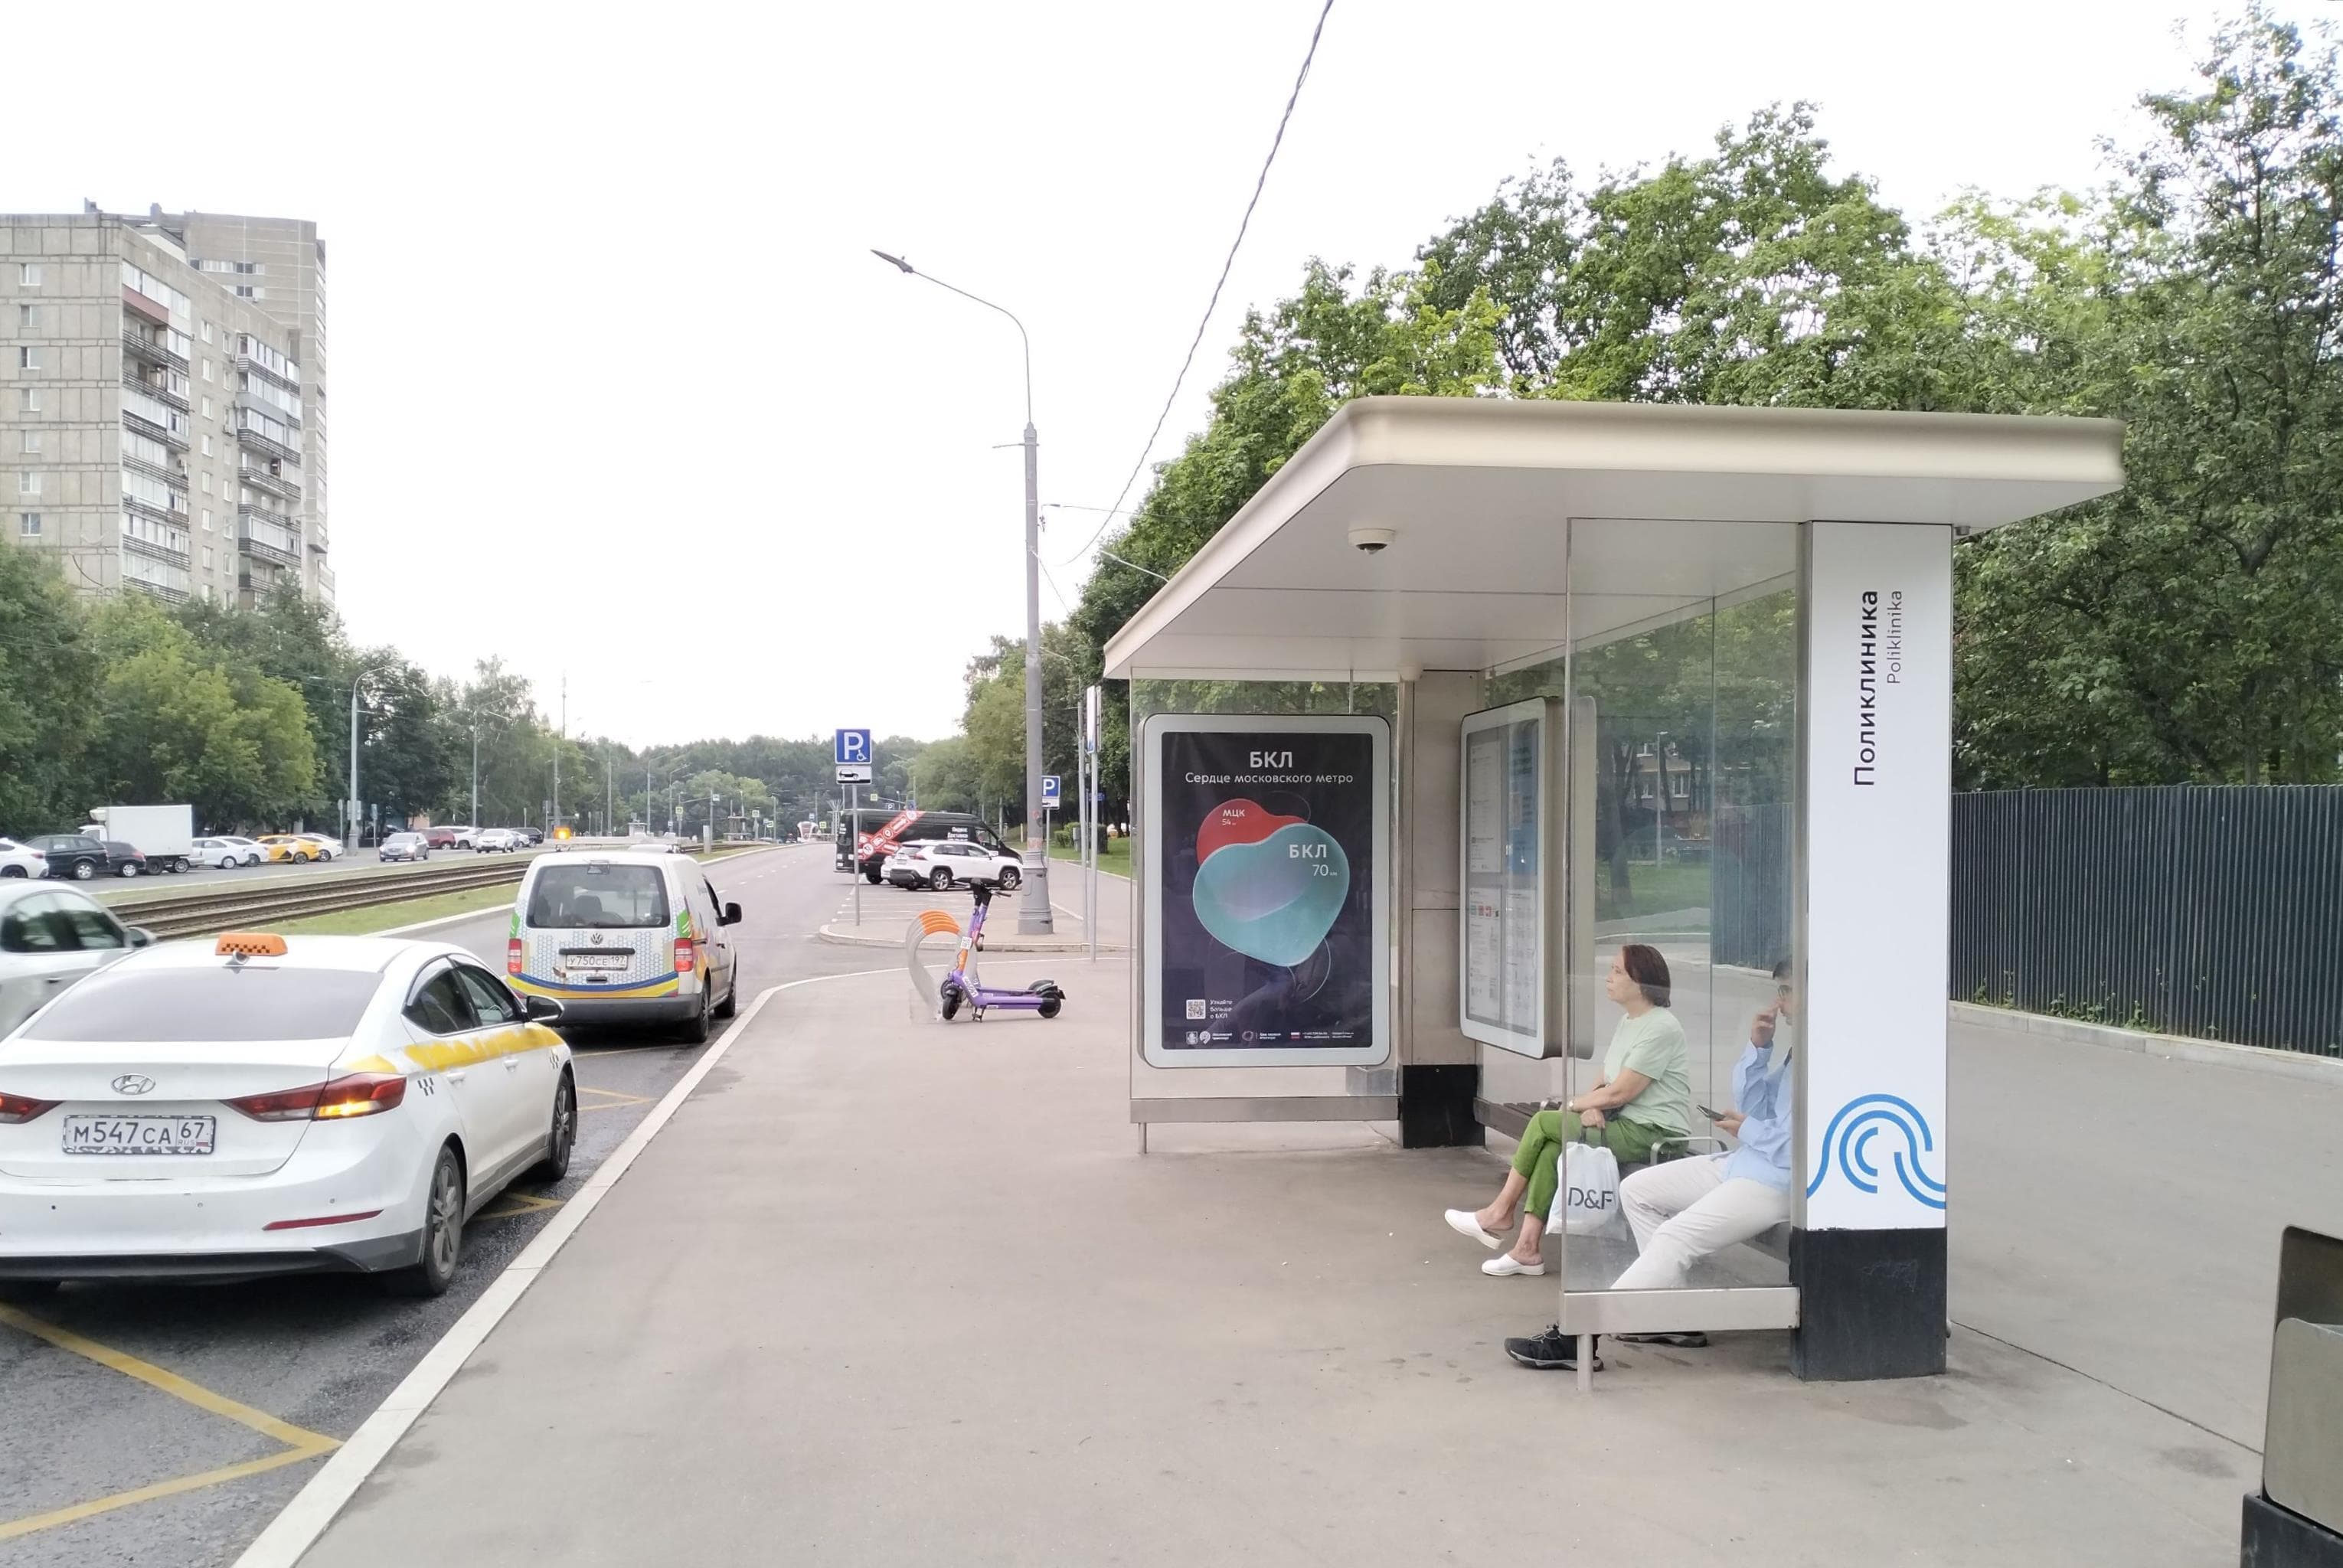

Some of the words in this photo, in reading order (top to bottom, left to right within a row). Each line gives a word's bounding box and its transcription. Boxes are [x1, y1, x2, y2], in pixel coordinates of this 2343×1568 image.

[1886, 590, 1902, 684] Poliklinika
[1854, 590, 1878, 786] Поликлиника
[844, 732, 864, 760] P
[1250, 751, 1292, 768] БКЛ
[1043, 779, 1055, 795] P
[1185, 772, 1230, 785] Сердце
[1234, 774, 1312, 783] московского
[1315, 774, 1354, 785] метро
[1222, 808, 1246, 818] МЦК
[1289, 844, 1327, 858] БКЛ
[1312, 864, 1329, 877] 70
[74, 1121, 172, 1145] М547СА
[180, 1122, 205, 1139] 67
[1567, 1187, 1613, 1210] D&F
